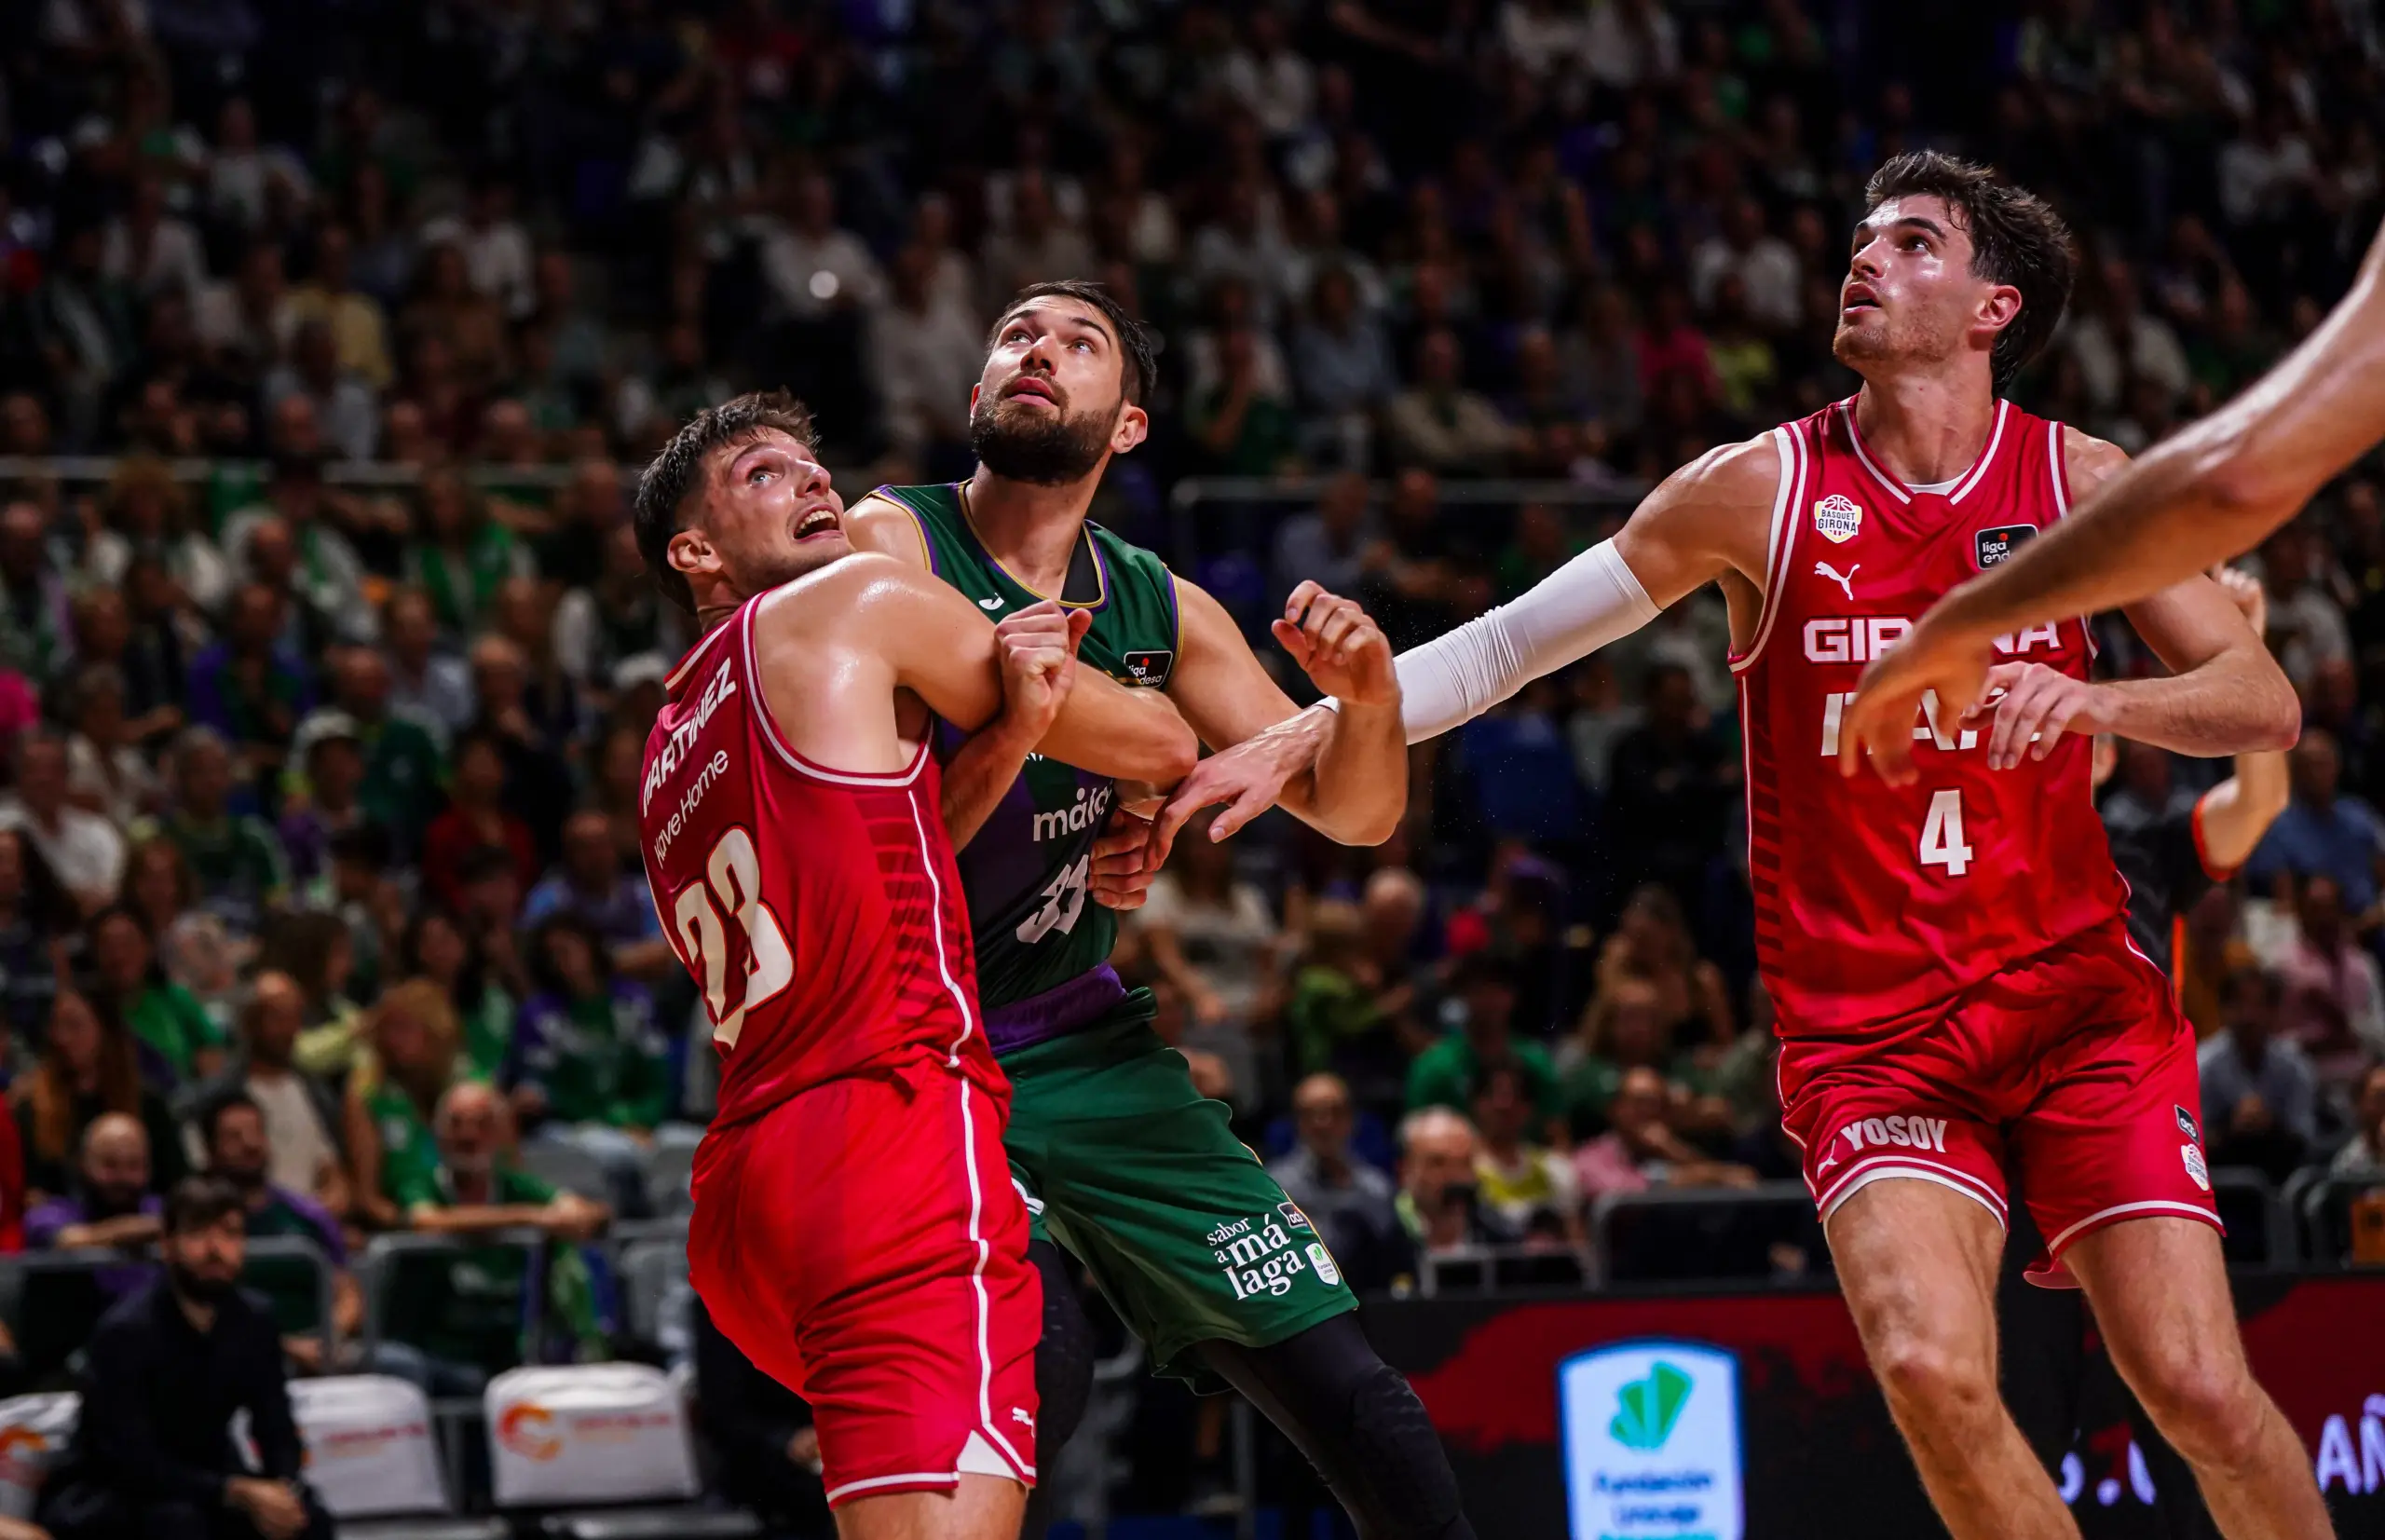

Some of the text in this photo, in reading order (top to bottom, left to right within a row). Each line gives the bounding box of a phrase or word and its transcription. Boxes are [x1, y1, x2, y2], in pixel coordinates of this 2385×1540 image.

[1818, 518, 1857, 534] GIRONA
[1821, 509, 1856, 521] BASQUET
[1982, 541, 2007, 553] liga
[1139, 675, 1163, 686] desa
[680, 750, 729, 823] Home
[1919, 788, 1973, 877] 4
[1840, 1115, 1948, 1153] YOSOY
[1206, 1217, 1251, 1247] sabor
[1214, 1213, 1291, 1269] a má
[1222, 1249, 1306, 1301] laga
